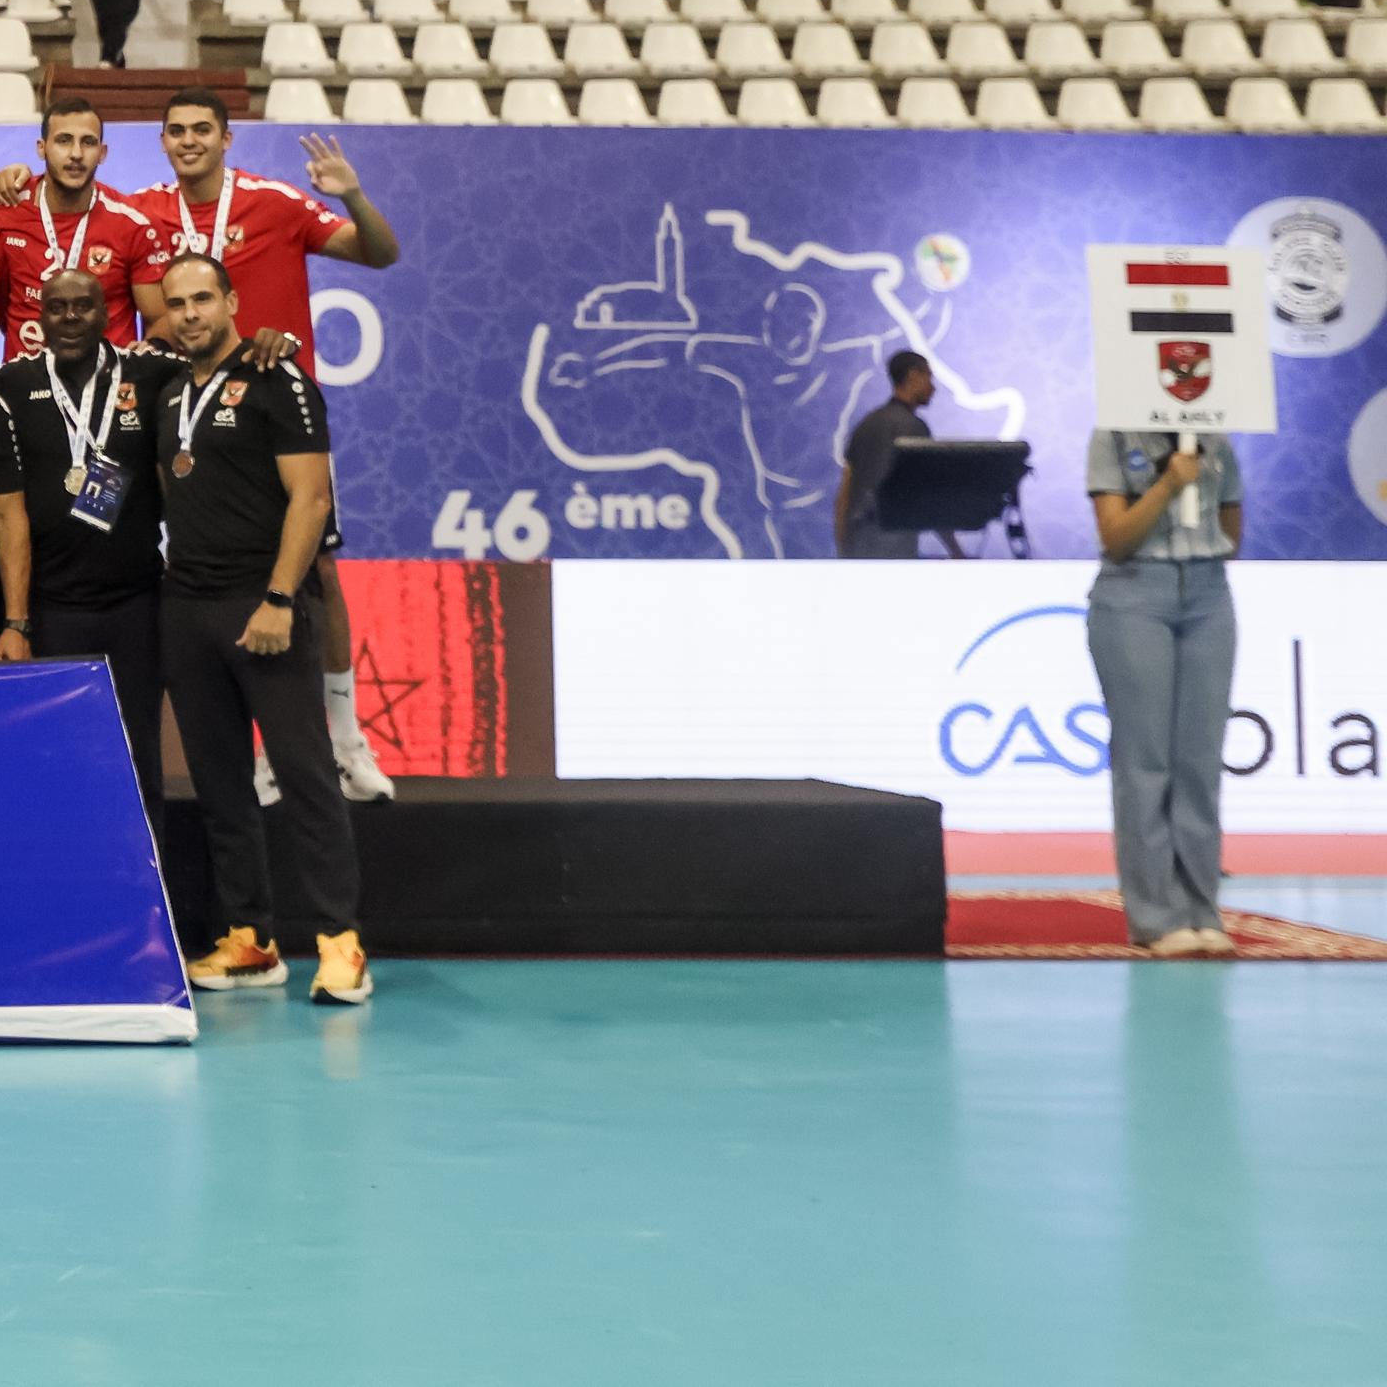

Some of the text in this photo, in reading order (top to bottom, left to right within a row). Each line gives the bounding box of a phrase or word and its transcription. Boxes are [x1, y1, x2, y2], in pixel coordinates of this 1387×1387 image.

[29, 389, 52, 400] JAKO
[433, 480, 690, 559] 46 ème
